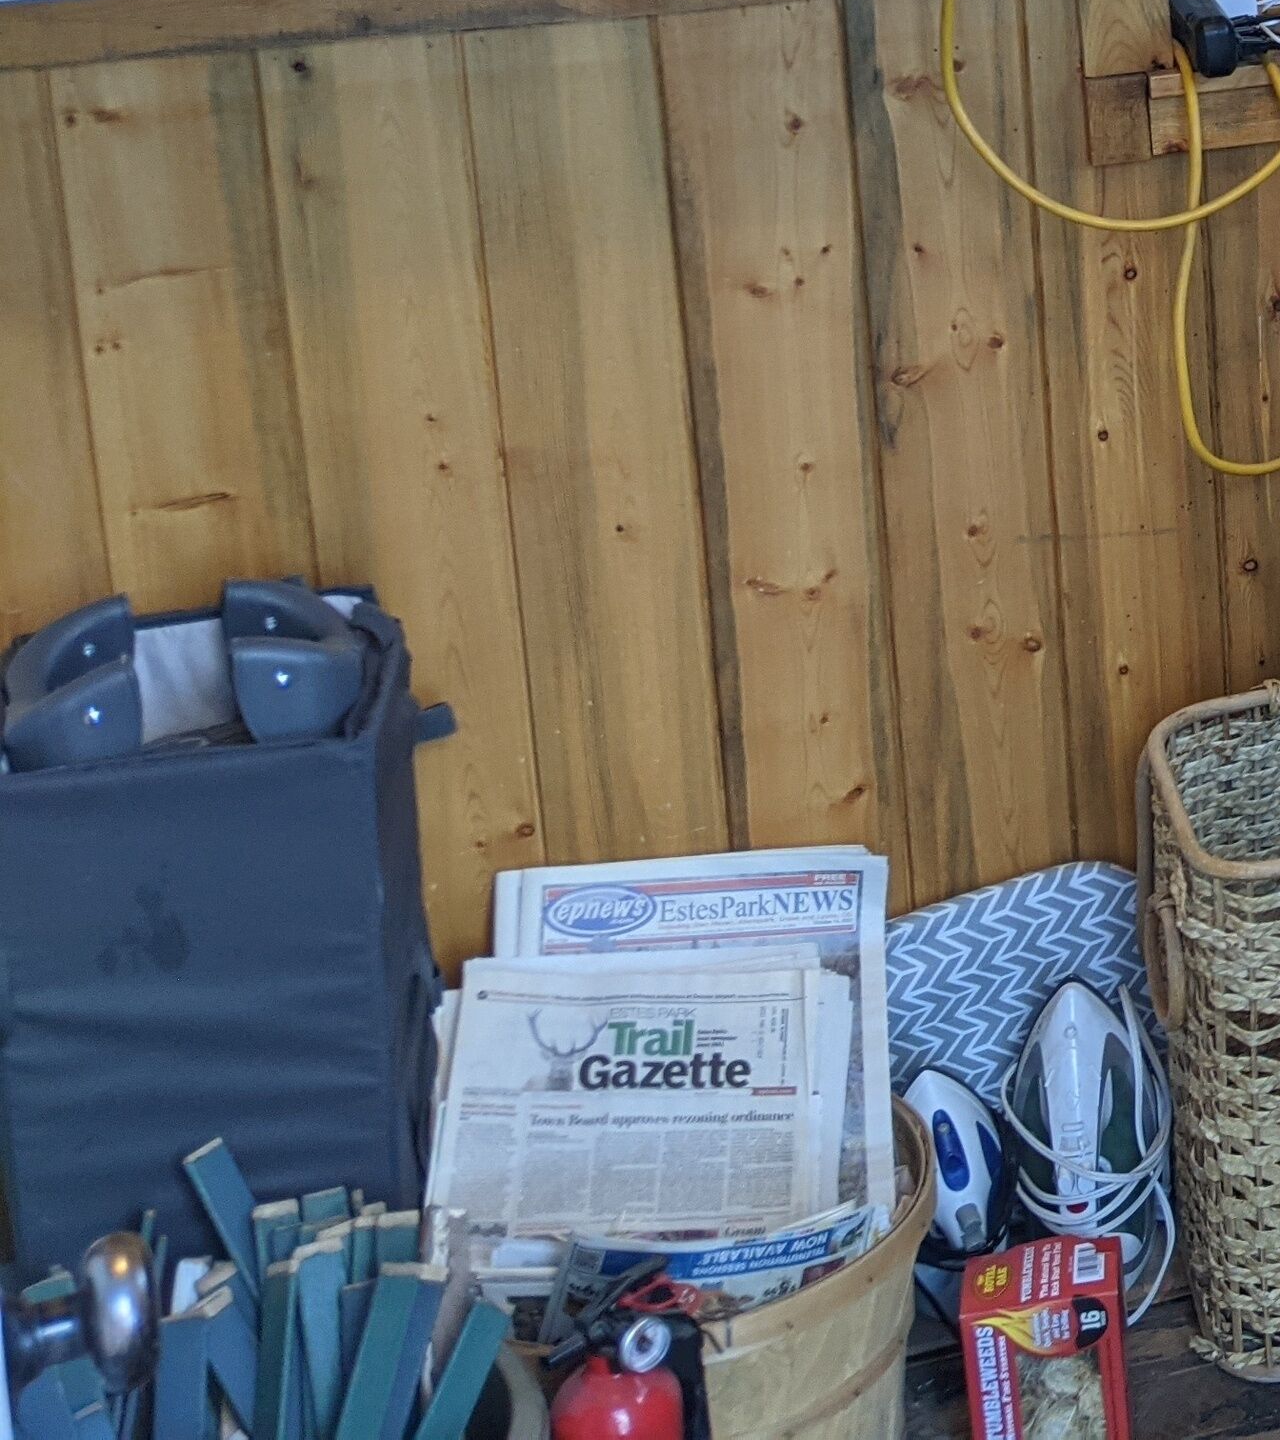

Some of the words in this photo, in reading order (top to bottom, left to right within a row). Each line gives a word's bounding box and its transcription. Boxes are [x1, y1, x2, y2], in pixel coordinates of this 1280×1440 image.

[660, 887, 854, 923] EstesParkNEWS
[607, 1019, 695, 1056] Trail
[578, 1052, 751, 1091] Gazette
[1079, 1310, 1101, 1331] 16
